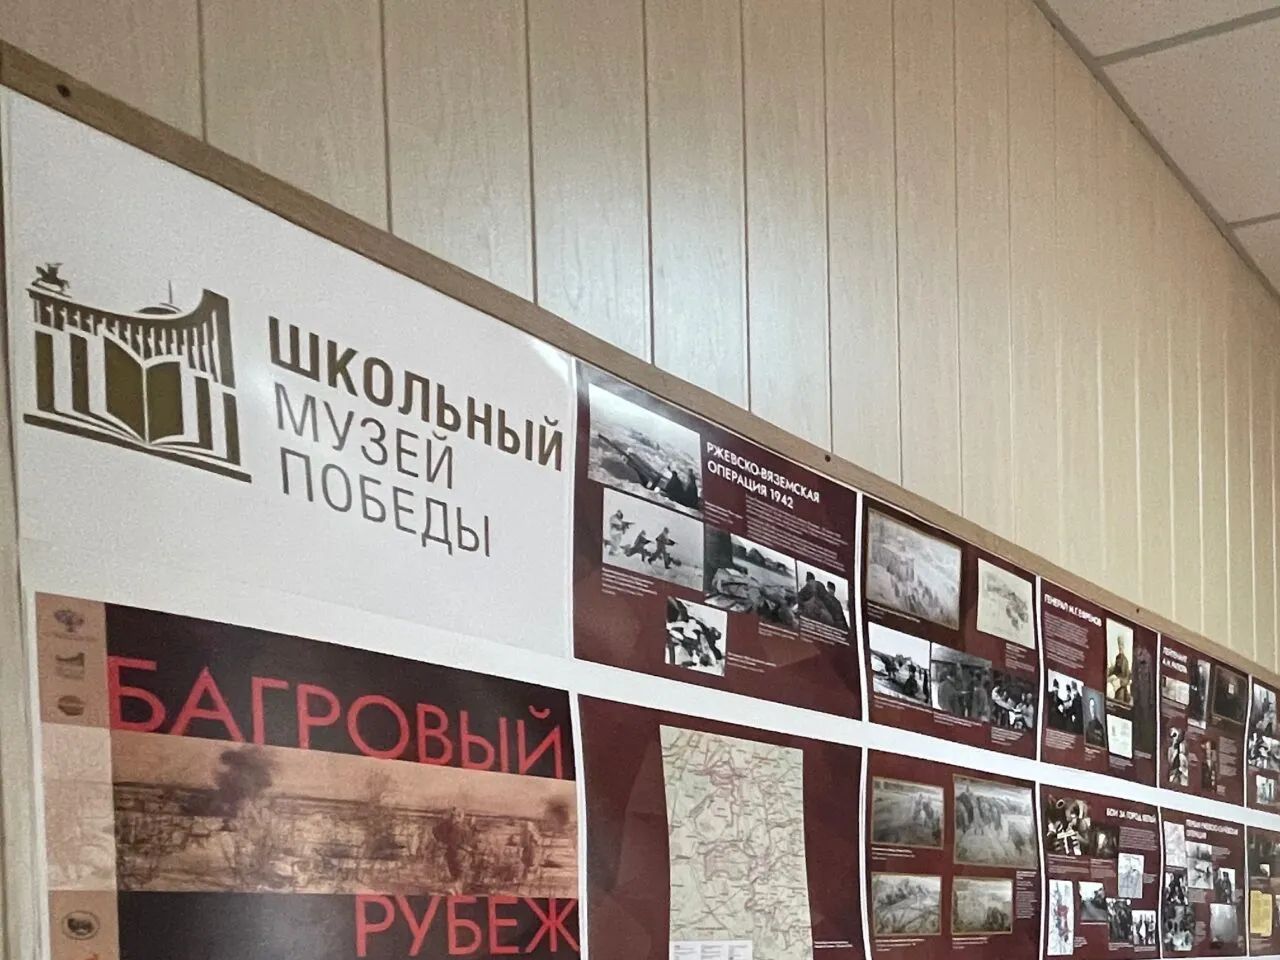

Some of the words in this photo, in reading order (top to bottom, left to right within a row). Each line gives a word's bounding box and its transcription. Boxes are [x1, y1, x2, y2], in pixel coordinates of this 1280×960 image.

[268, 315, 563, 471] ШКОЛЬНЫЙ
[274, 382, 454, 489] МУЗЕЙ
[280, 447, 490, 557] ПОБЕДЫ
[706, 441, 820, 503] РЖЕВСКО-ВЯЗЕМСКАЯ
[707, 460, 768, 497] ОПЕРАЦИЯ
[770, 488, 794, 509] 1942
[107, 655, 564, 780] БАГРОВЫЙ
[355, 893, 580, 958] РУБЕЖ
